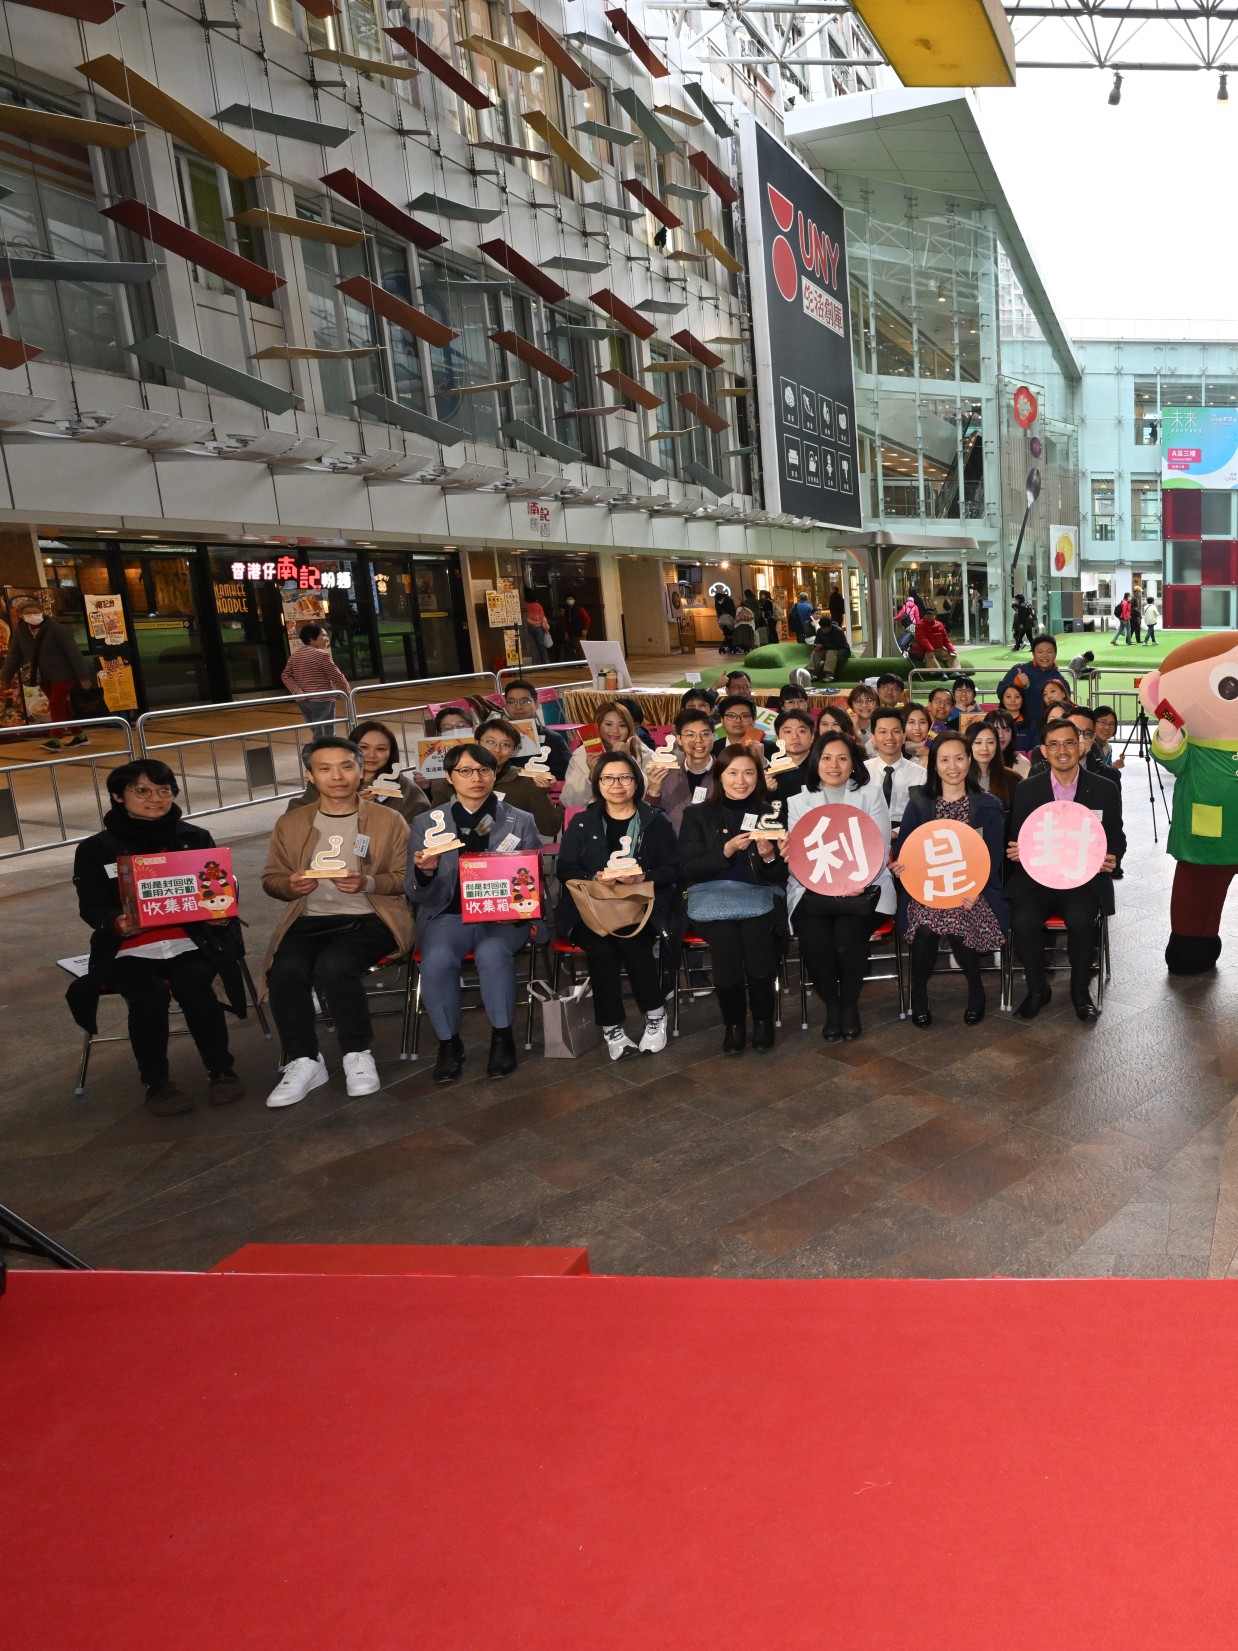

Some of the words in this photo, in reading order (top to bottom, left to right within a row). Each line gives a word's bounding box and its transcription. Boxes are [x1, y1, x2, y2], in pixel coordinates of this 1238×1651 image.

[798, 210, 839, 290] UNY
[231, 556, 351, 588] 香港仔南記粉麵
[213, 583, 247, 597] NAMKEE
[216, 598, 249, 613] NOODLE
[803, 816, 870, 884] 利
[1029, 812, 1096, 879] 封
[924, 829, 975, 901] 是
[141, 877, 194, 890] 利是封回收
[465, 882, 508, 890] 利是封回收
[142, 888, 196, 898] 重用大行動
[466, 889, 508, 898] 重用大行動
[143, 896, 198, 916] 收集箱
[466, 899, 510, 914] 收集箱
